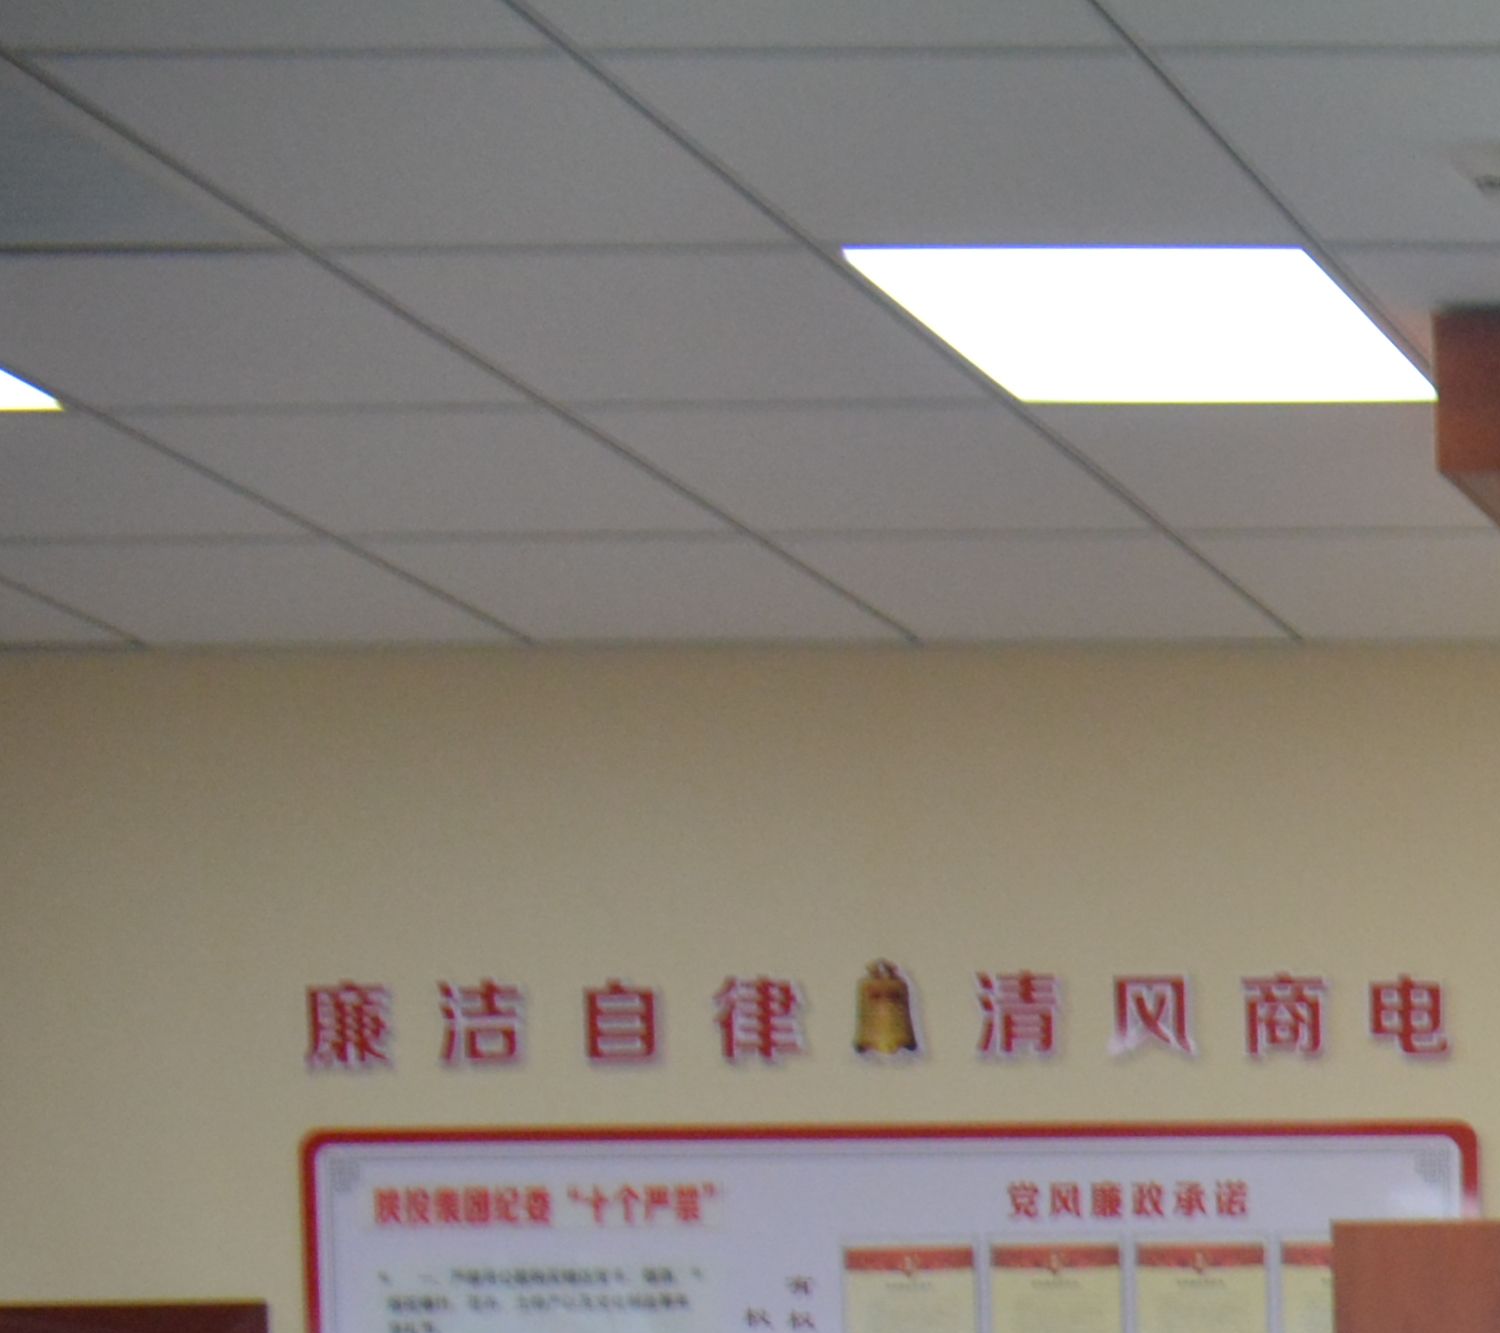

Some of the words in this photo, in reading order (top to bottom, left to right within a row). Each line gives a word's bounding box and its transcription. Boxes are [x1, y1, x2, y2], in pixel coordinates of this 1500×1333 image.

[304, 980, 802, 1065] 廉洁自律
[975, 971, 1452, 1059] 清风商电
[1007, 1179, 1251, 1220] 党风廉政承诺
